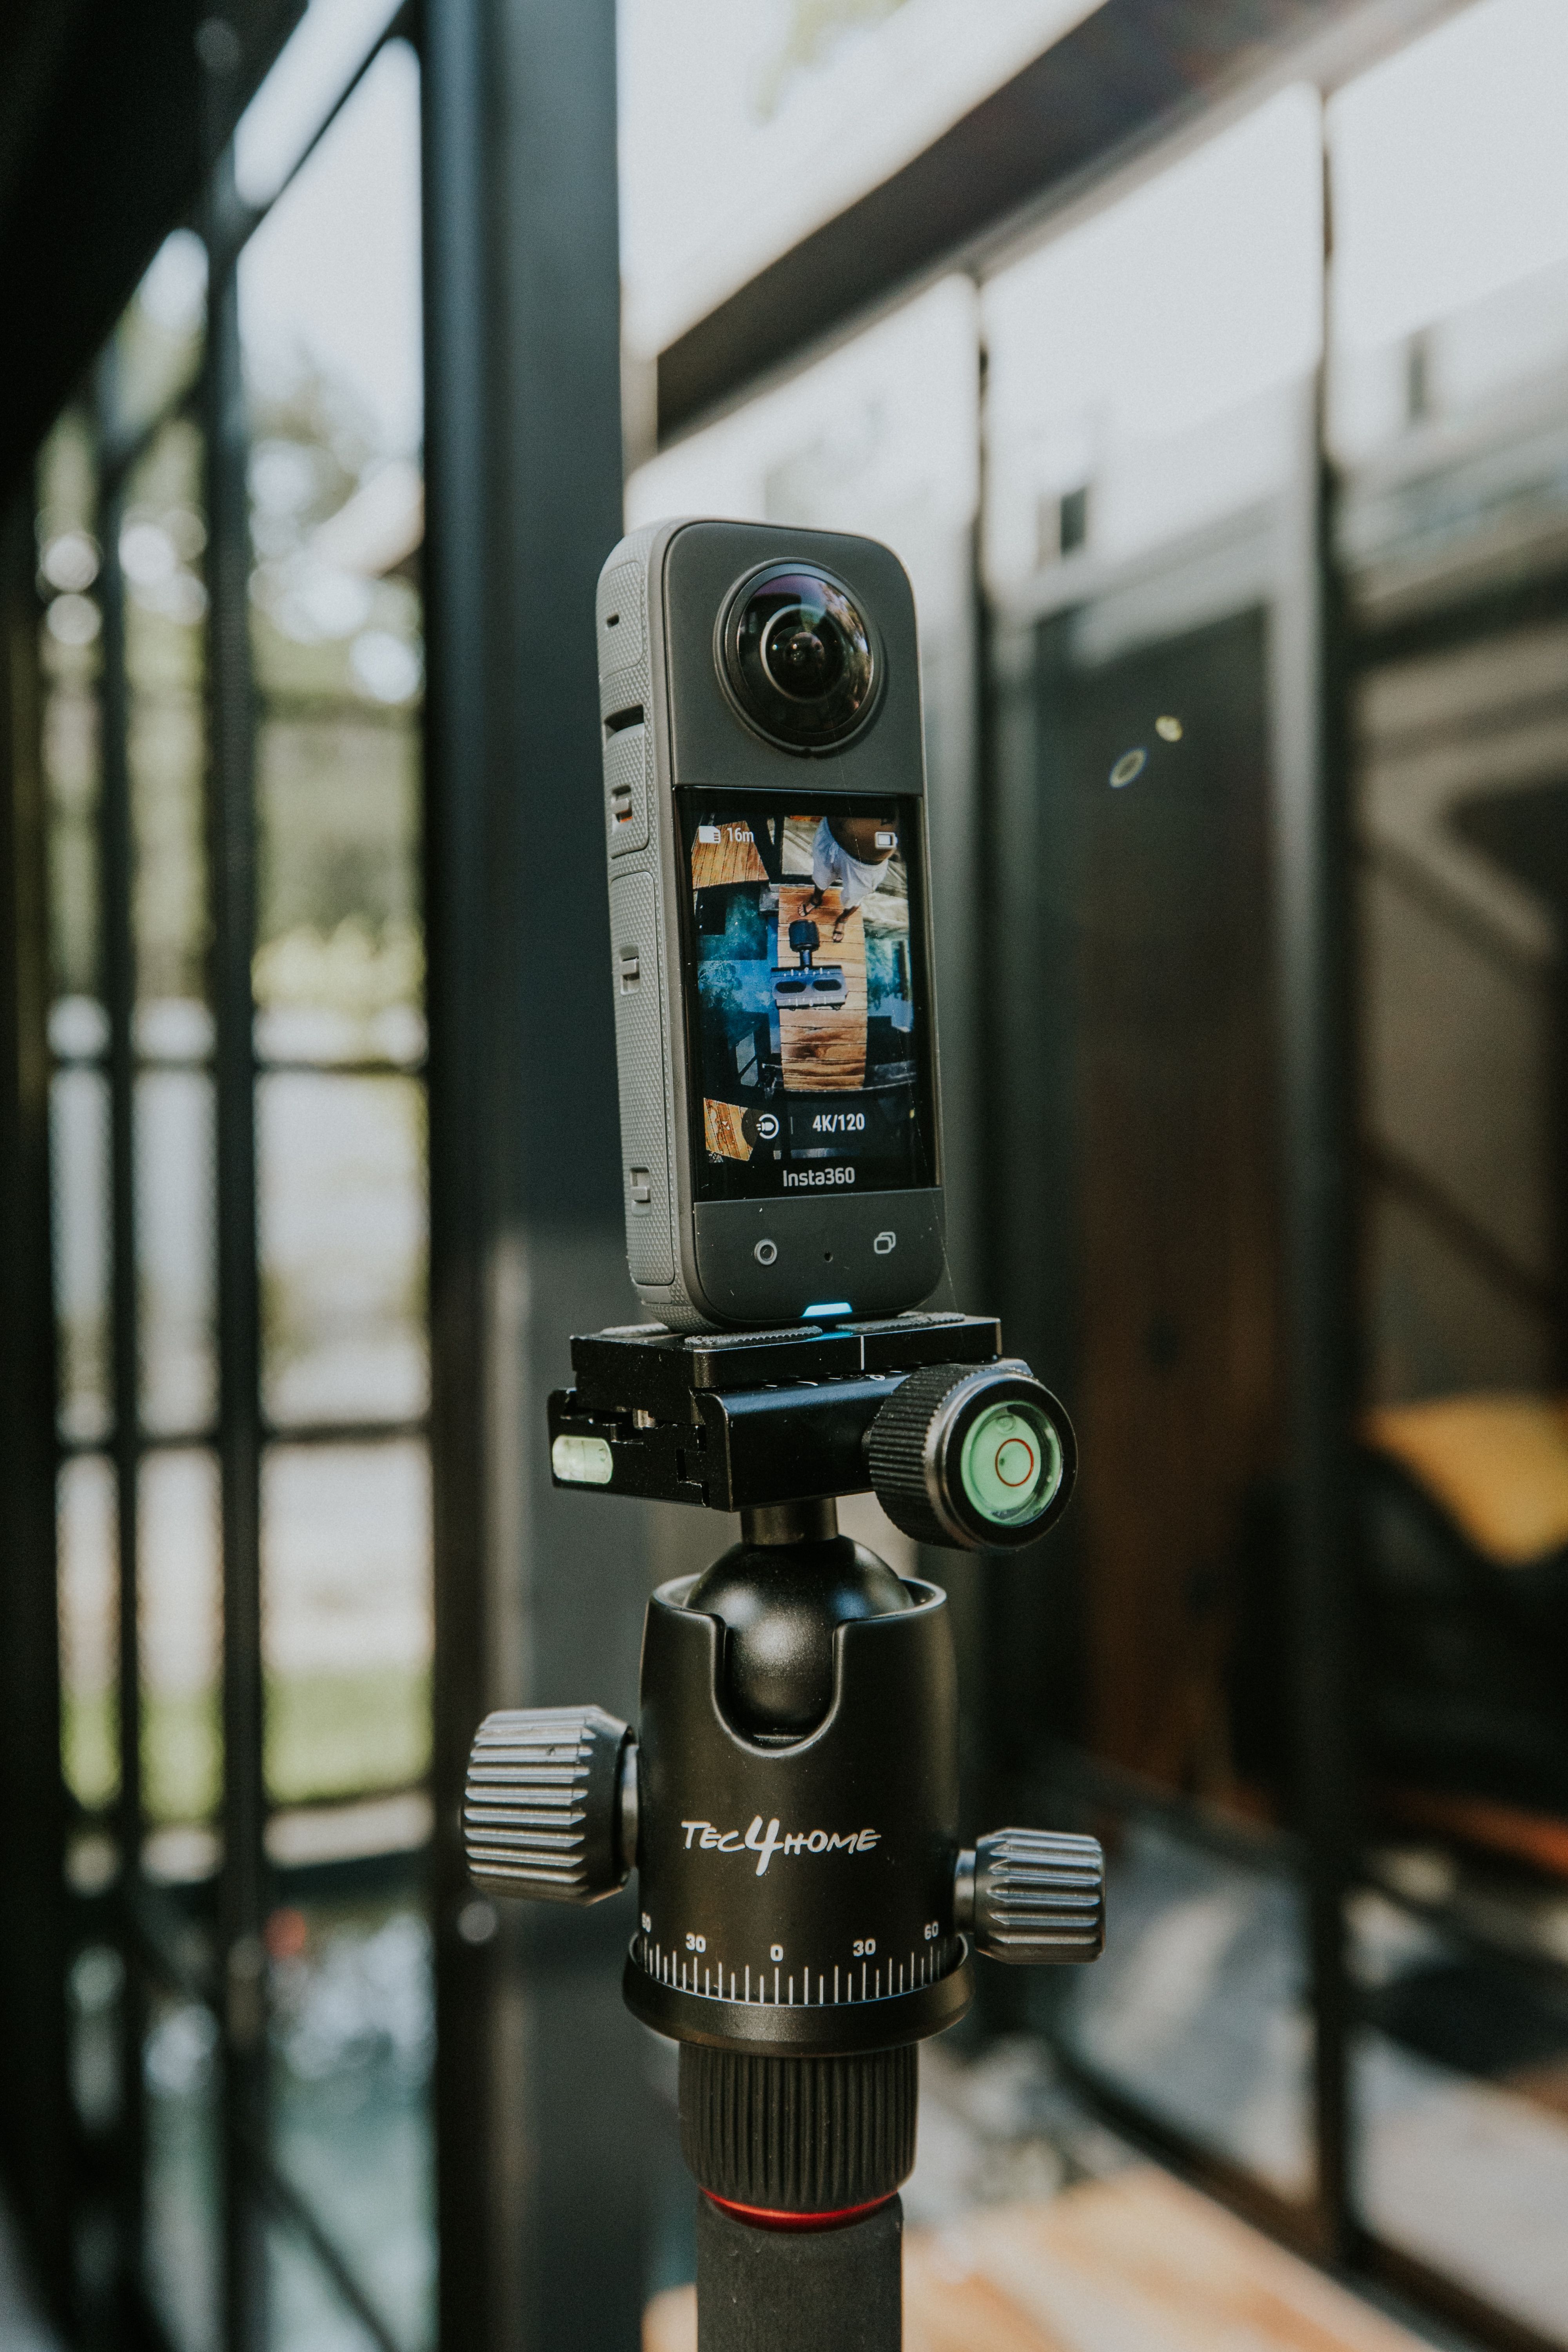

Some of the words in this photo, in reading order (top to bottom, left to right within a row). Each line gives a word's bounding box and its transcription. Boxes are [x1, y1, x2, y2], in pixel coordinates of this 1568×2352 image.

[727, 827, 754, 842] 16m
[812, 1113, 865, 1132] 4K/120
[783, 1167, 855, 1187] Insta360
[686, 1932, 706, 1953] 30
[770, 1944, 784, 1962] 0
[853, 1938, 876, 1957] 30
[924, 1921, 939, 1940] 60
